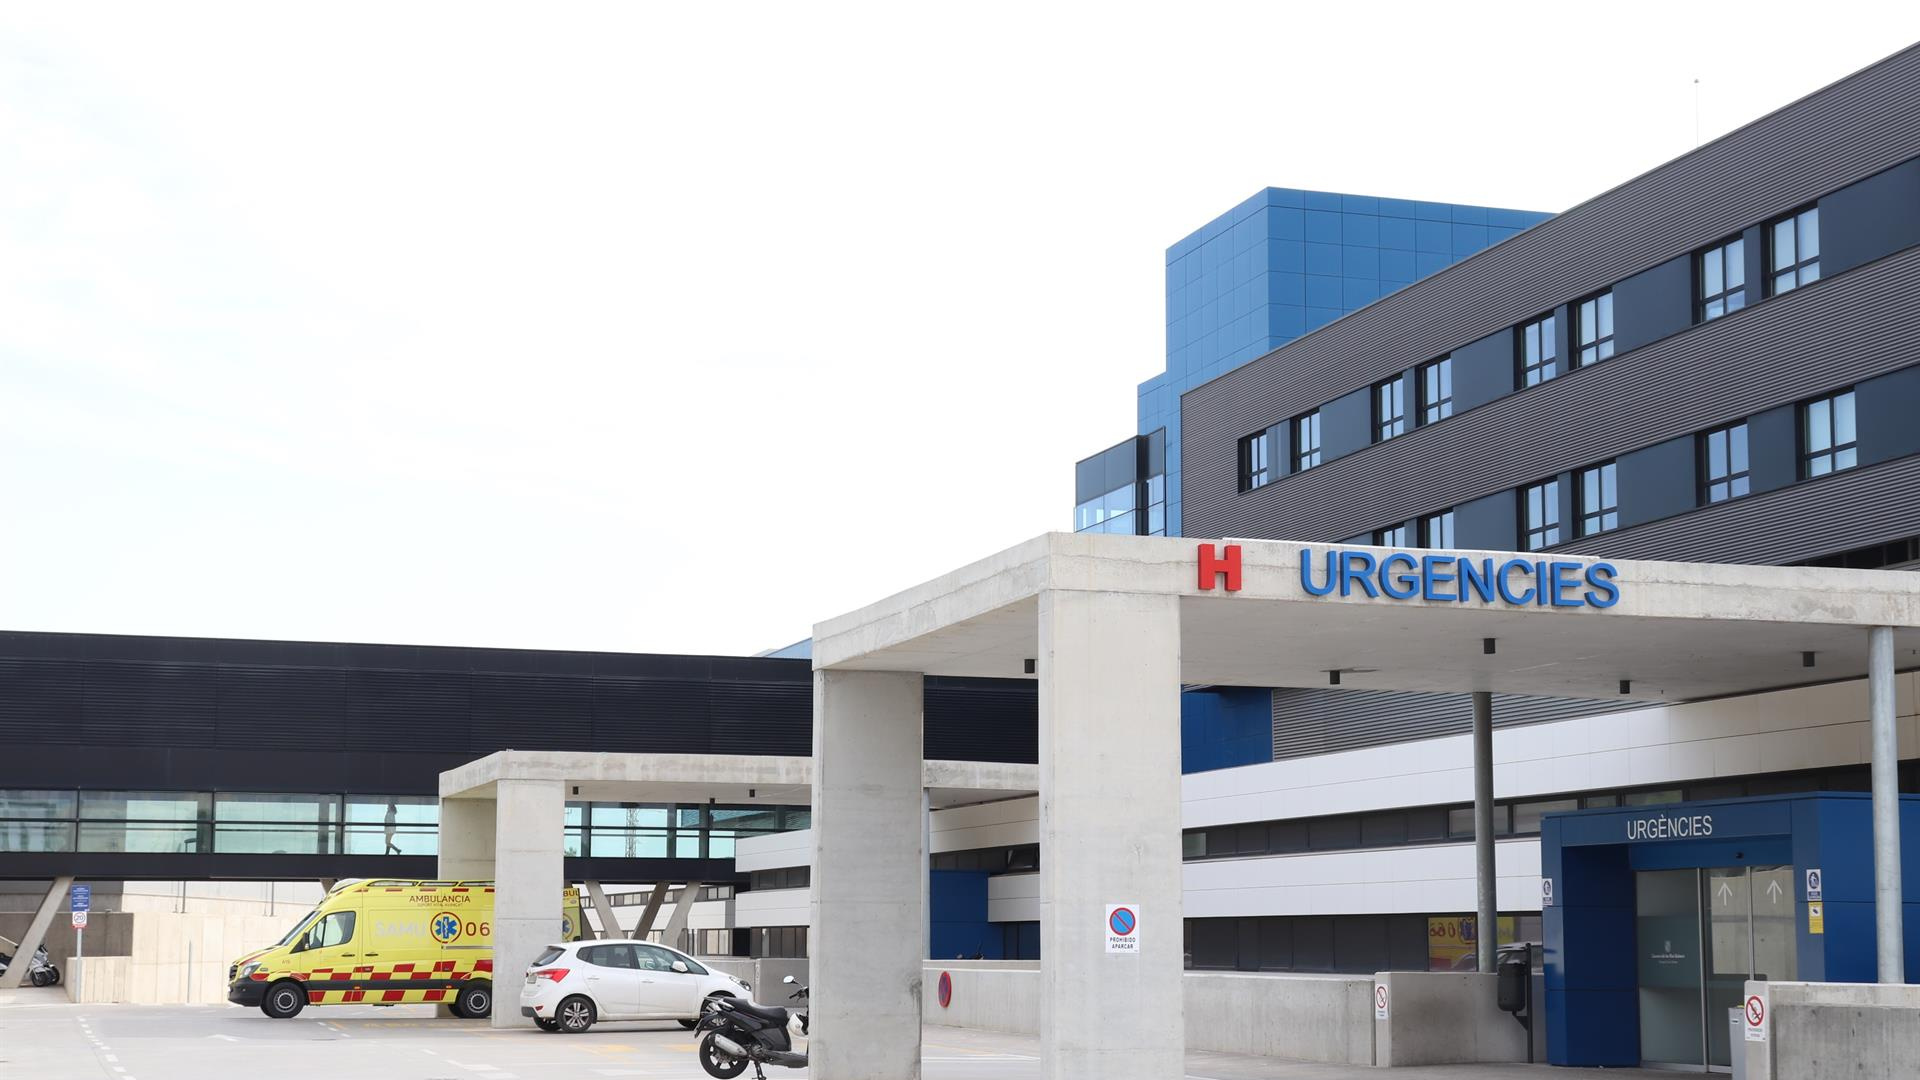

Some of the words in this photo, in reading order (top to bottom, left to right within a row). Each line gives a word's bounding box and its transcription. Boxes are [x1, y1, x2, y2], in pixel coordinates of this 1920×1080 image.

[1198, 543, 1242, 592] H
[1300, 548, 1620, 608] URGENCIES
[1627, 814, 1713, 840] URGÈNCIES
